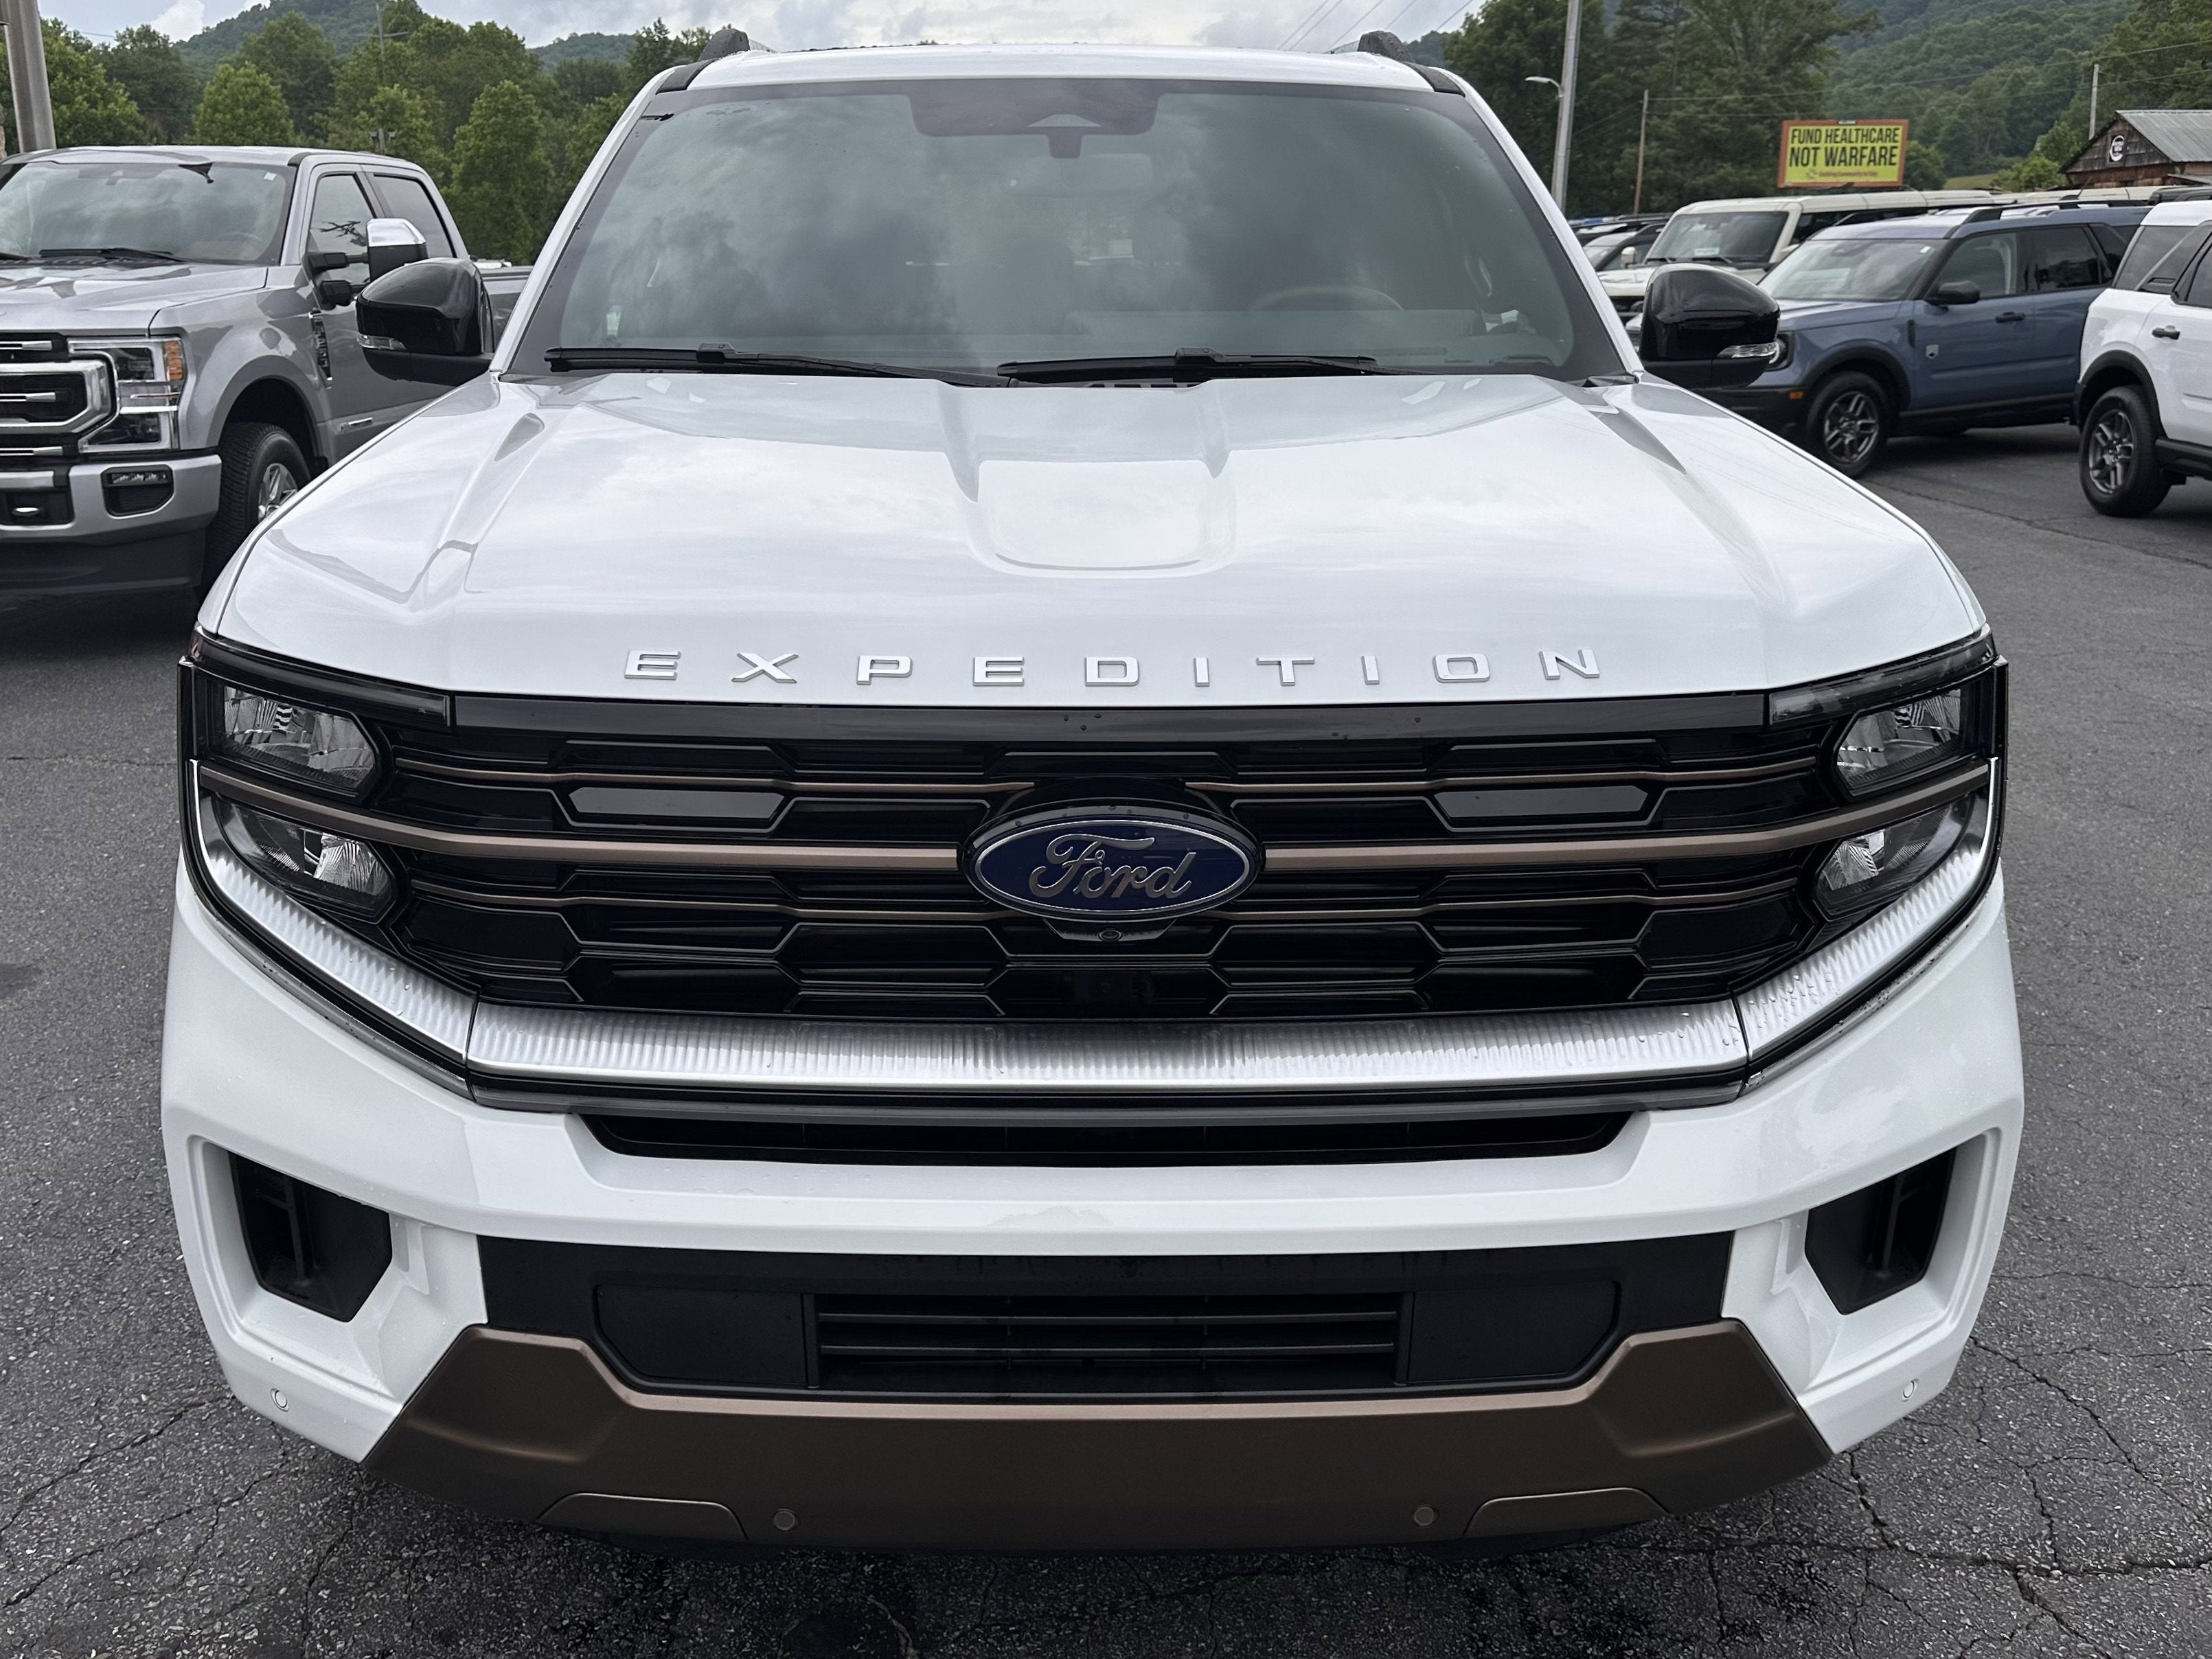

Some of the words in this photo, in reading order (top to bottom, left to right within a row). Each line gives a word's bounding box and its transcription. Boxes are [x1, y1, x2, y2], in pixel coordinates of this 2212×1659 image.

[1791, 128, 1822, 144] FUND
[1825, 128, 1900, 144] HEALTHCARE
[1789, 147, 1820, 167] NOT
[1824, 146, 1898, 166] WARFARE
[624, 648, 1601, 687] EXPEDITION
[1029, 833, 1197, 899] Ford
